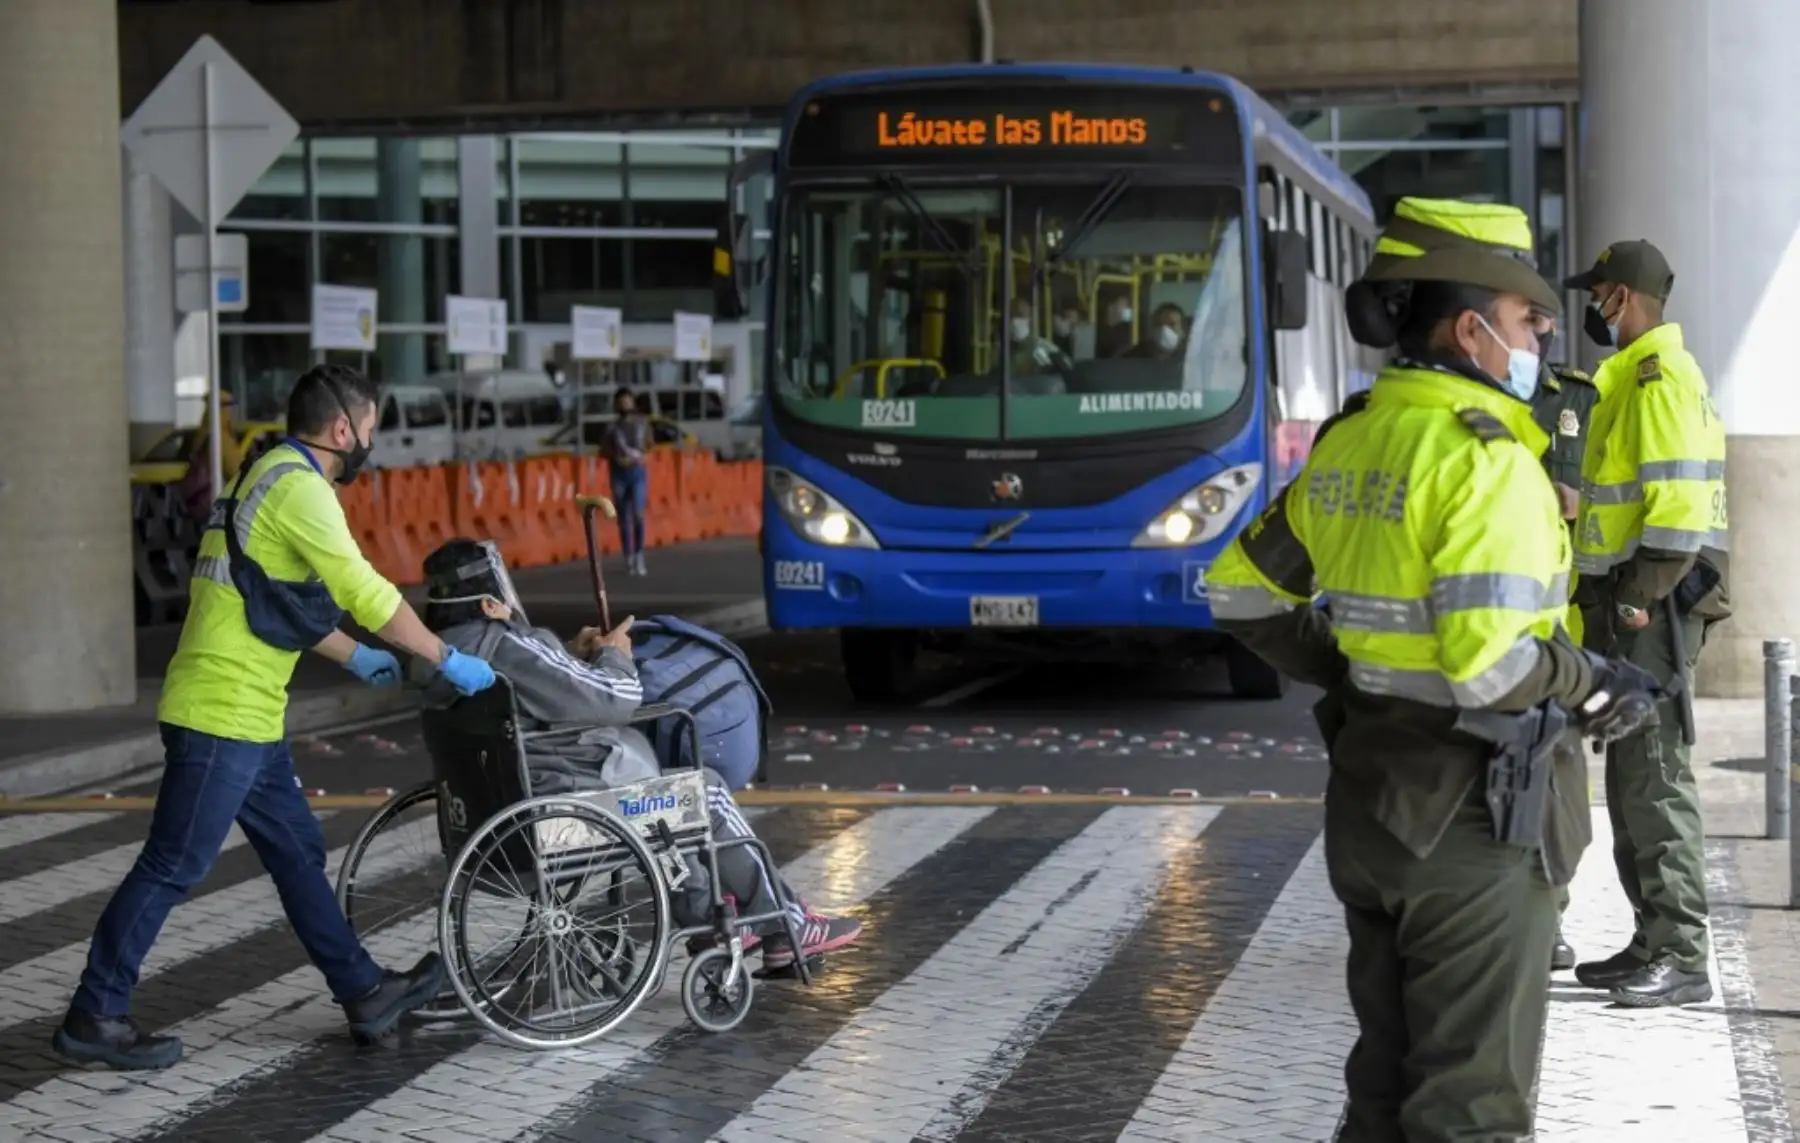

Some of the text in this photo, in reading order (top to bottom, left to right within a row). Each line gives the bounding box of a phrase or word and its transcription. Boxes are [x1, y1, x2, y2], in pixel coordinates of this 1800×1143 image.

[878, 110, 1147, 146] Lávate las Manos
[862, 400, 916, 423] E0241
[1079, 391, 1203, 413] ALIMENTADOR
[775, 561, 824, 585] E0241
[618, 795, 676, 816] Talma
